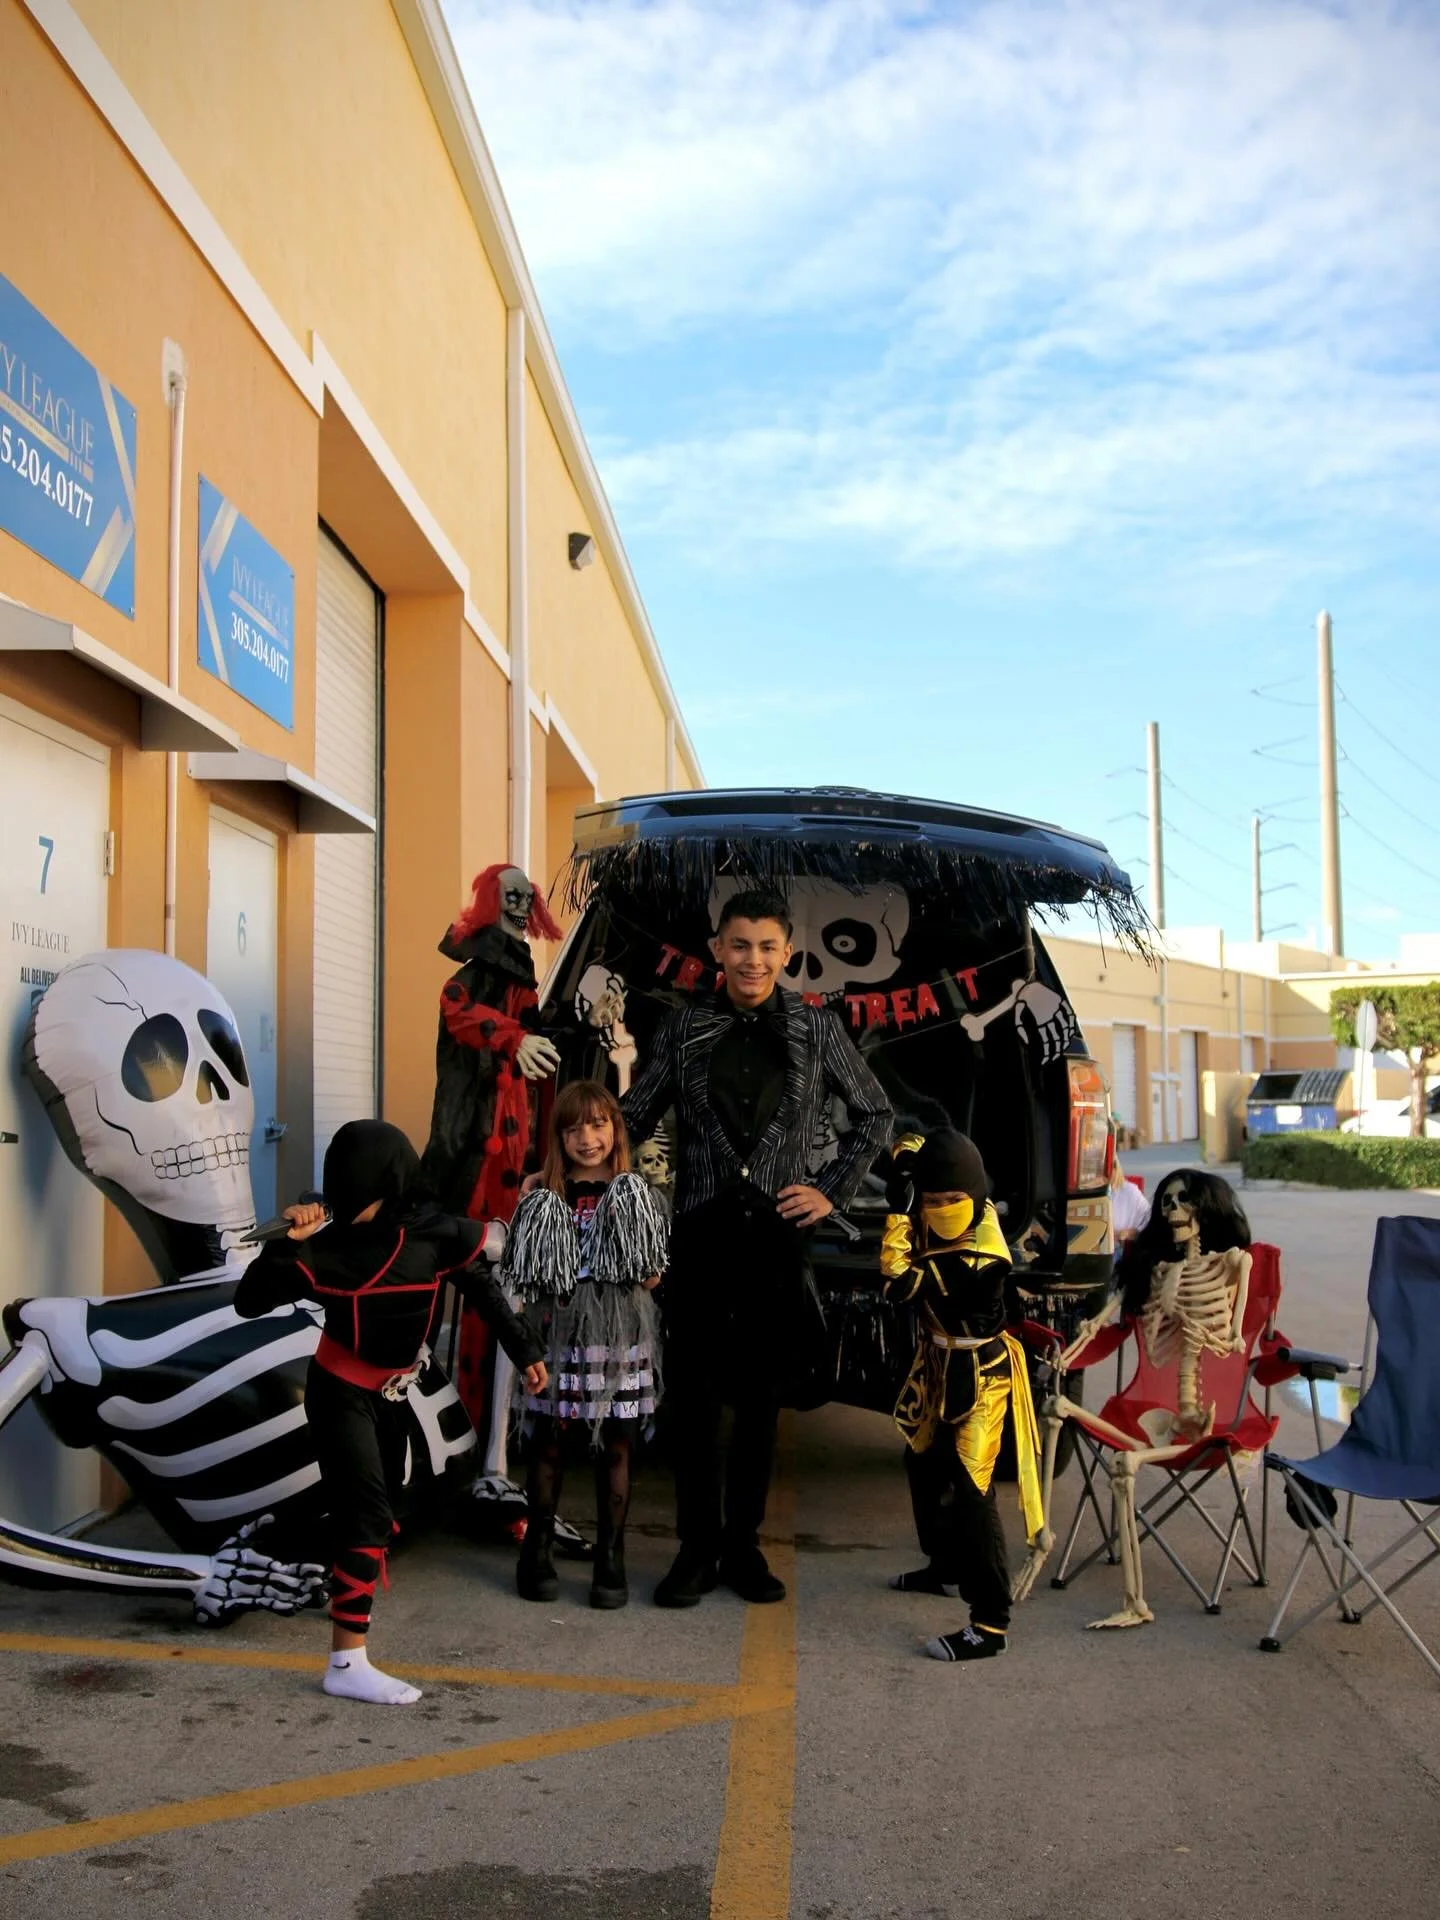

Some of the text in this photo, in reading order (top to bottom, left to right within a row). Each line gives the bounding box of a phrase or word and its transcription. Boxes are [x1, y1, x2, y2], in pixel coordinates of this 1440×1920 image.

[20, 361, 95, 465] LEAGUE
[233, 554, 251, 600] IVY
[231, 612, 288, 684] 305.204.0177
[39, 835, 54, 894] 7
[12, 922, 71, 953] IVY LEAGUE
[237, 911, 248, 958] 6
[20, 966, 30, 984] ALL
[845, 968, 978, 1032] TREAT
